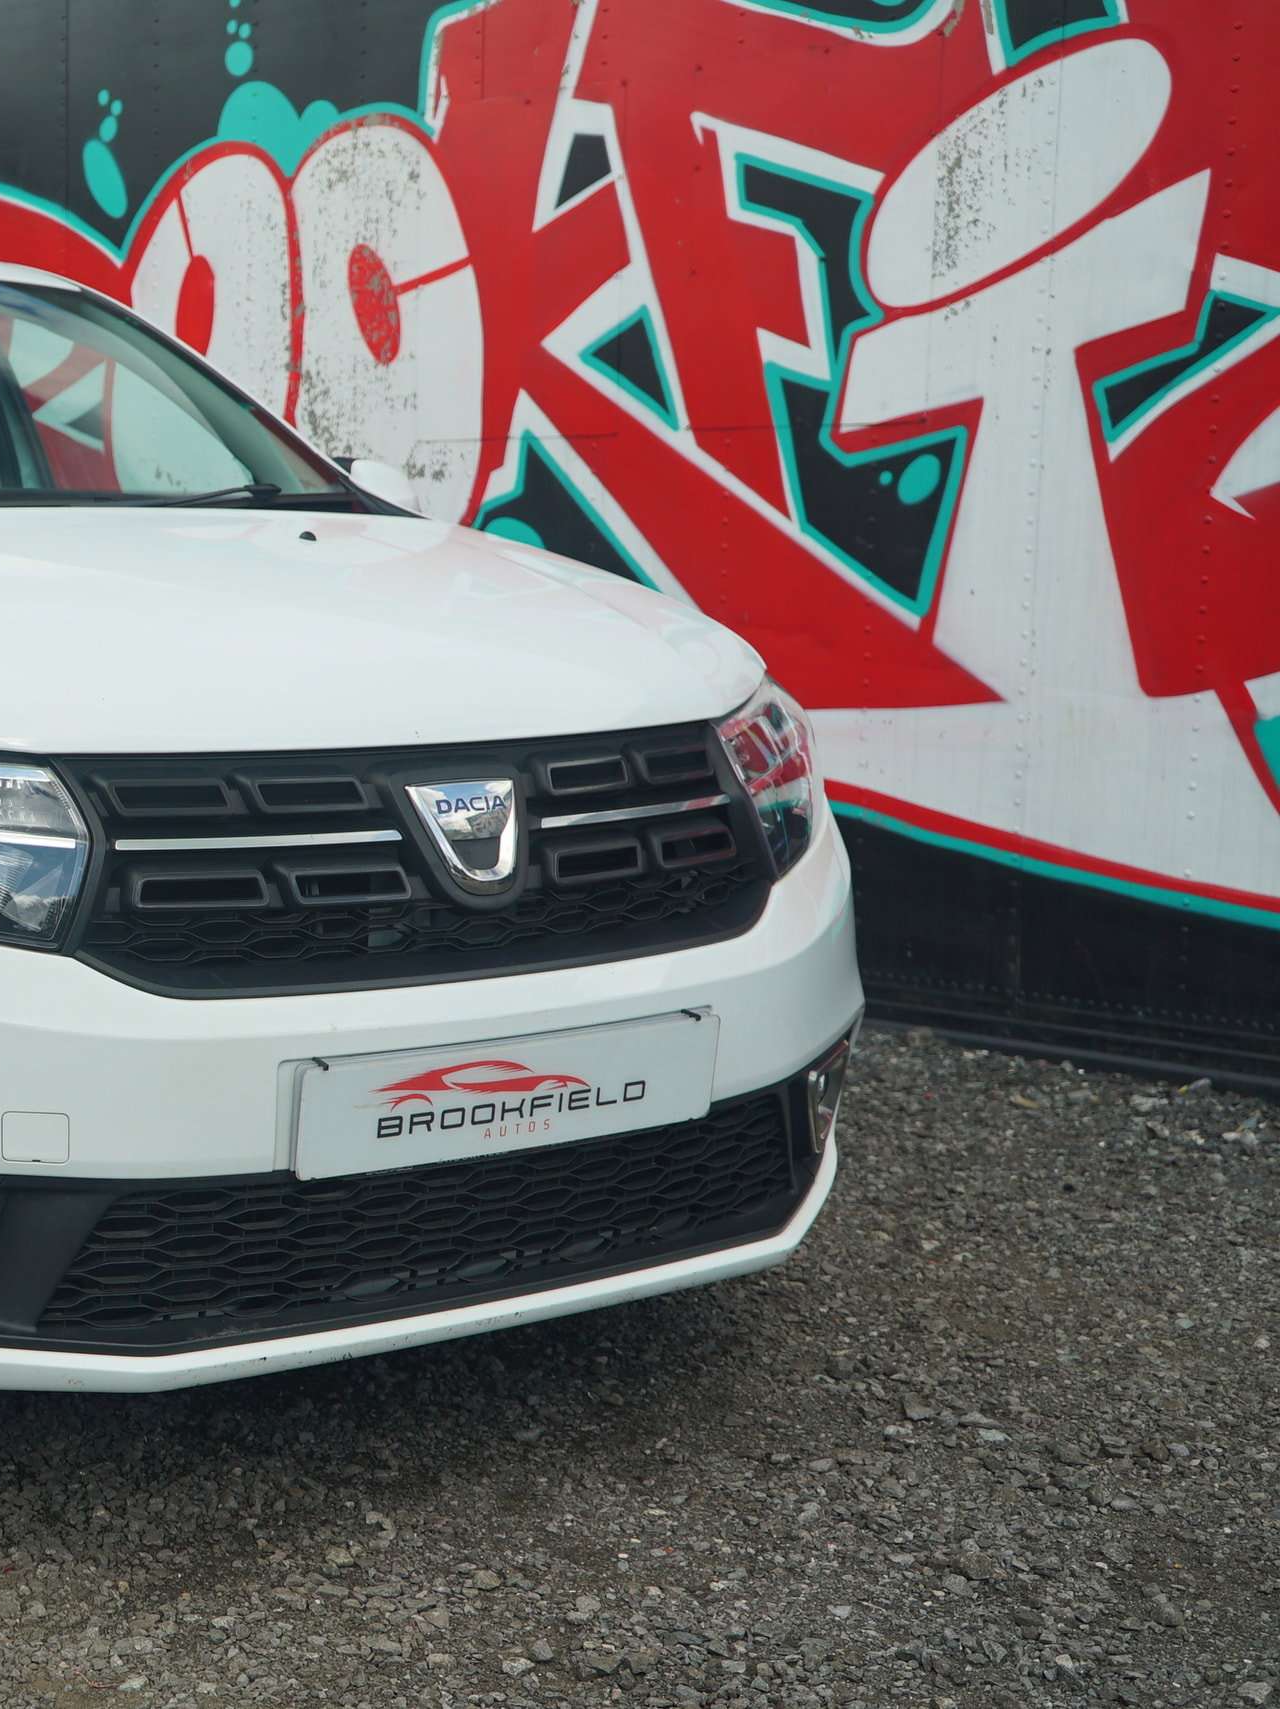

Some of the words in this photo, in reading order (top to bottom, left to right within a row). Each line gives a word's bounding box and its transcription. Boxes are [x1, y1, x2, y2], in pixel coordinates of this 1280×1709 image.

[435, 795, 506, 815] DACIA
[376, 1079, 646, 1139] BROOKFIELD
[483, 1119, 551, 1139] AUTOS
